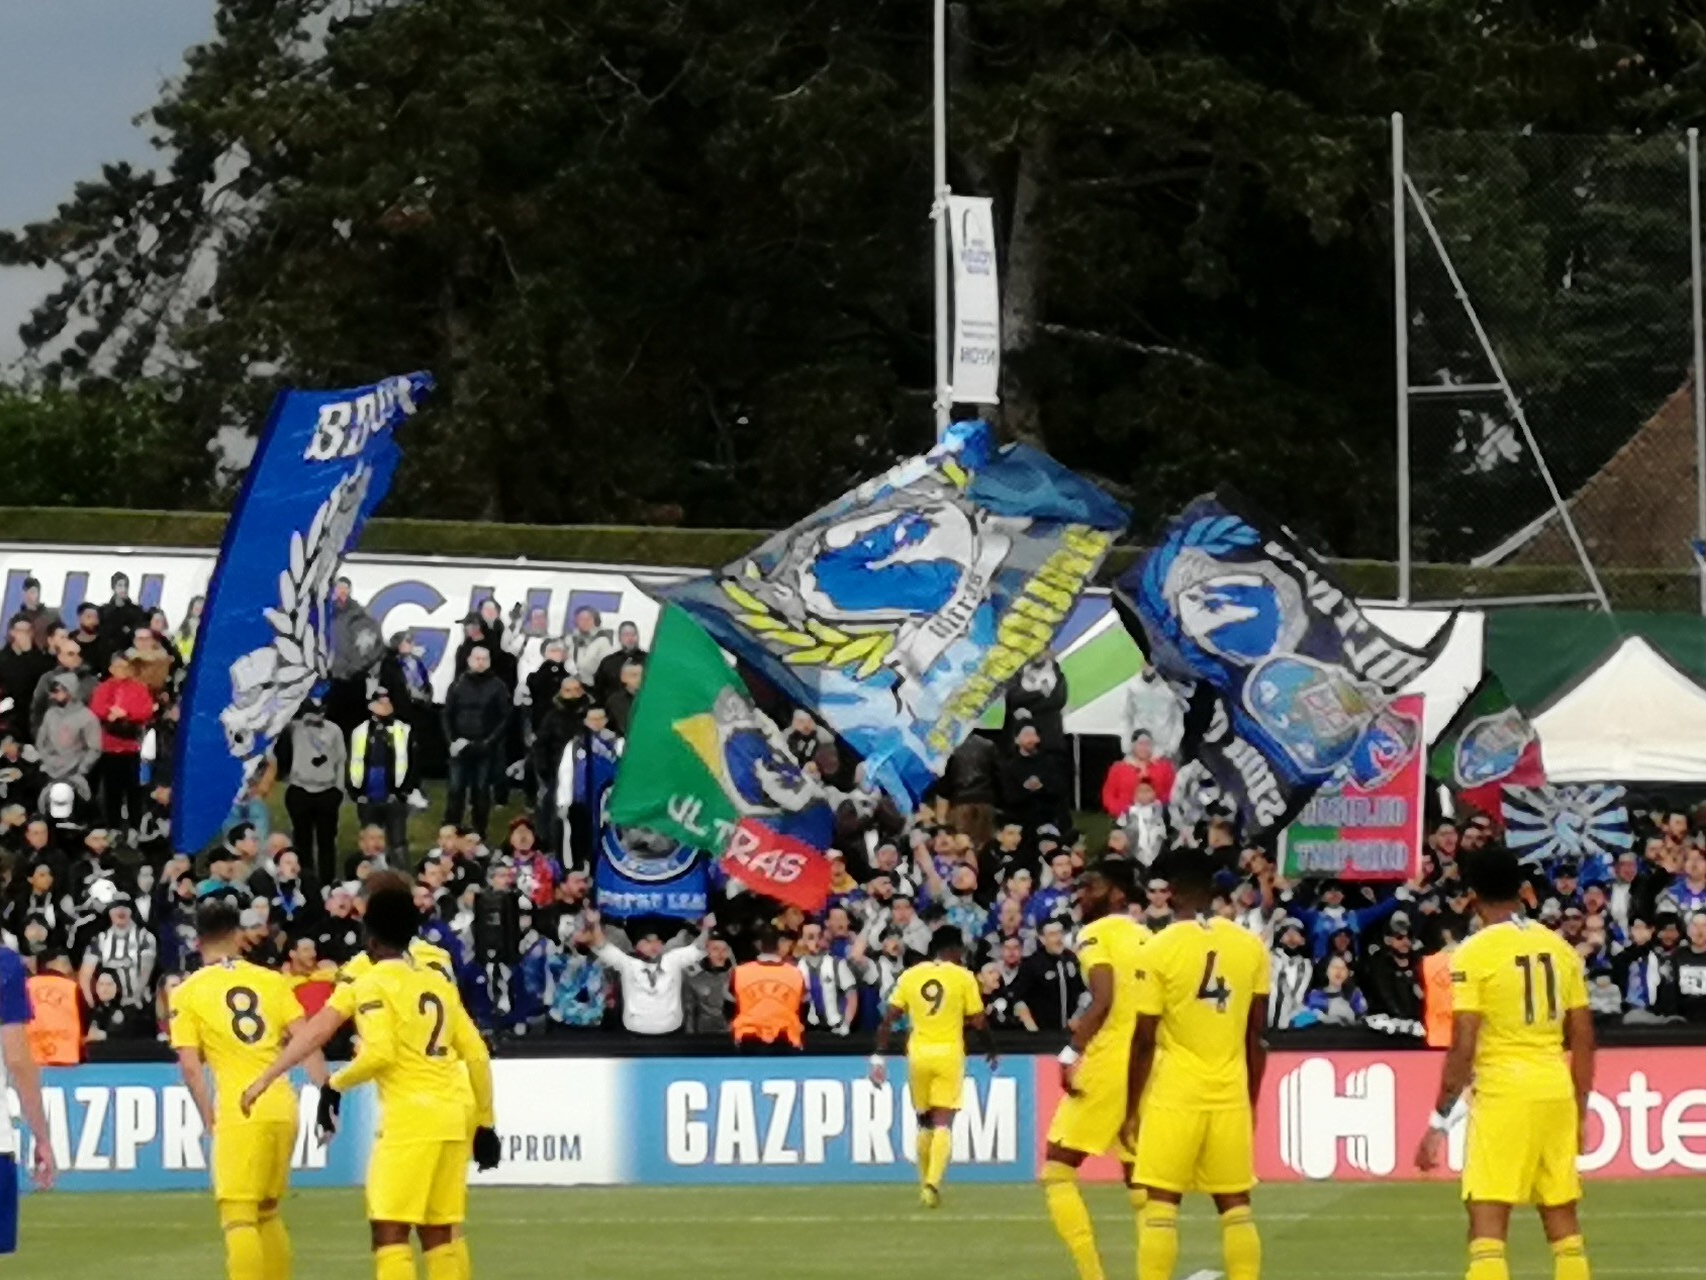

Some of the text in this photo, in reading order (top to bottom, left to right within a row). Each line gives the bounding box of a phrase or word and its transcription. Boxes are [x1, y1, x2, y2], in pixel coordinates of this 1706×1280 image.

[920, 978, 945, 1017] 9
[1196, 949, 1233, 1014] 4
[1515, 952, 1558, 1025] 11
[225, 986, 266, 1045] 8
[418, 991, 448, 1057] 2
[6, 1085, 328, 1170] AZPRM
[666, 1078, 1017, 1165] GAZPRM
